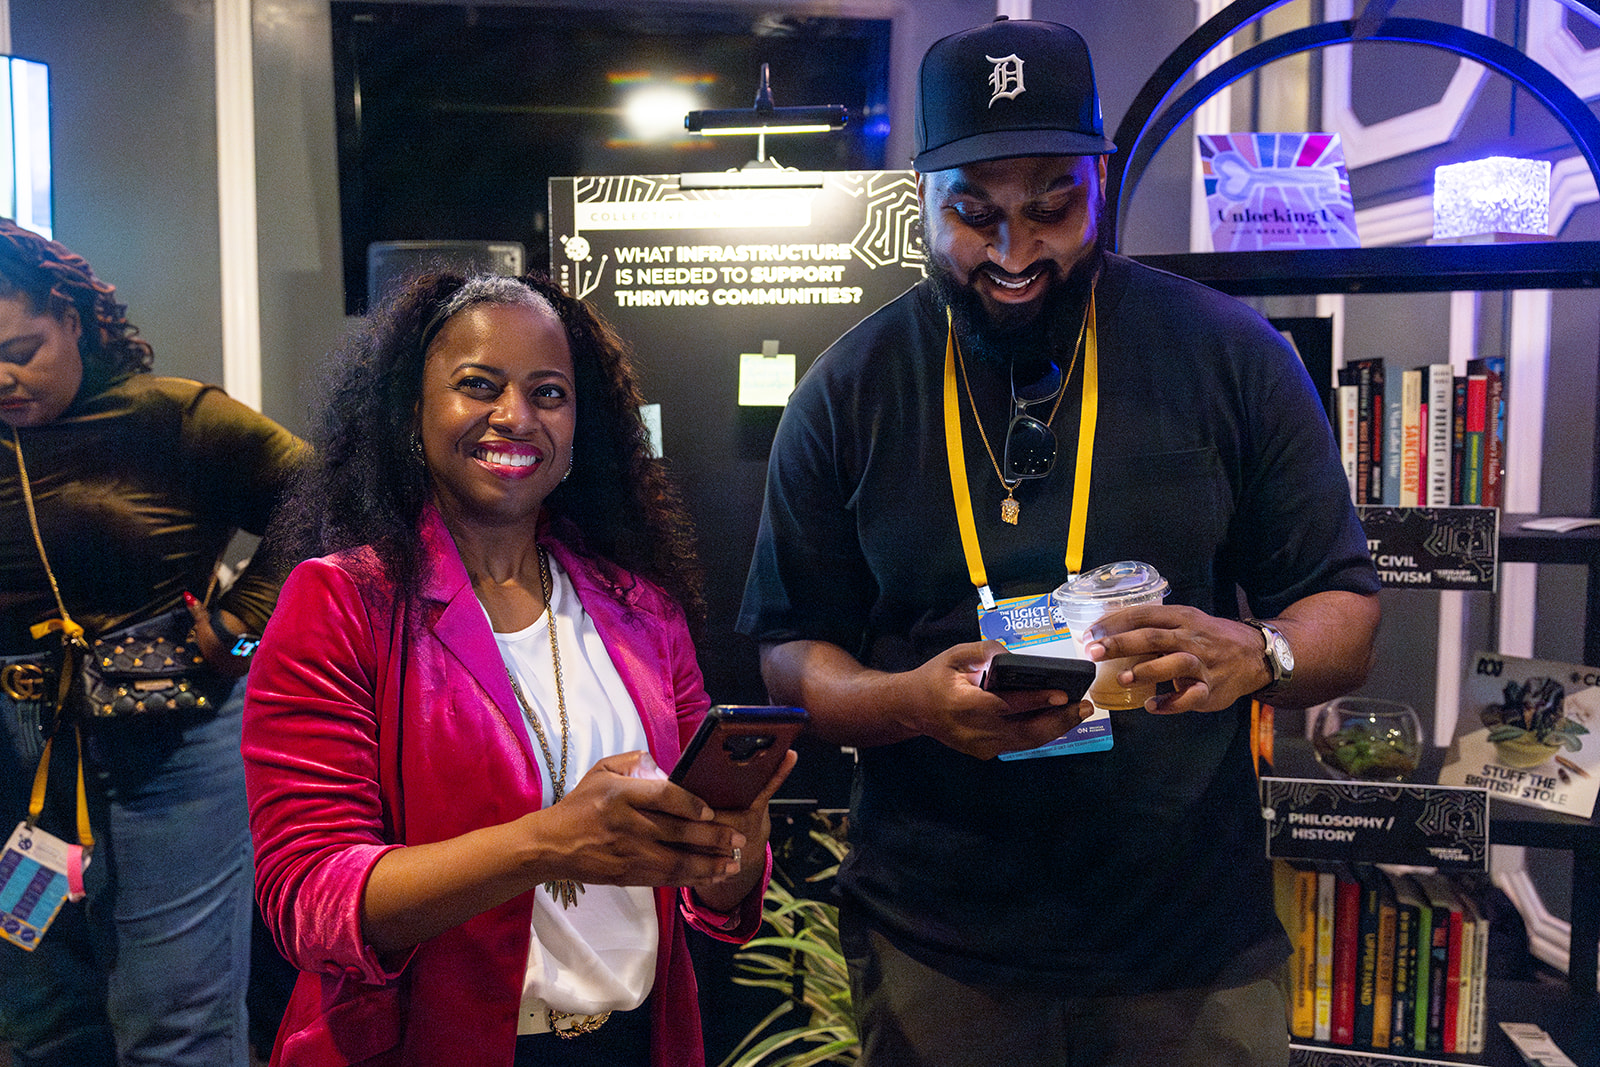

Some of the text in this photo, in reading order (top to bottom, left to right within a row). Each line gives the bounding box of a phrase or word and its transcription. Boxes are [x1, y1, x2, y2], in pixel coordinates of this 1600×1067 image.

[985, 53, 1026, 108] D
[1218, 208, 1318, 226] Unlocking
[614, 243, 852, 264] WHAT INFRASTRUCTURE
[616, 265, 845, 285] IS NEEDED TO SUPPORT
[615, 286, 863, 307] THRIVING COMMUNITIES?
[1434, 408, 1447, 453] PURPOSE
[1404, 424, 1419, 494] SANCTUARY
[1433, 471, 1446, 504] POWER
[1378, 554, 1418, 568] CIVIL
[1377, 570, 1432, 584] TIVISM
[1002, 616, 1050, 631] HOUSE
[1481, 764, 1557, 789] STUFF THE
[1465, 774, 1568, 806] BRITISH STOLE
[1288, 812, 1396, 831] PHILOSOPHY /
[1292, 829, 1356, 842] HISTORY
